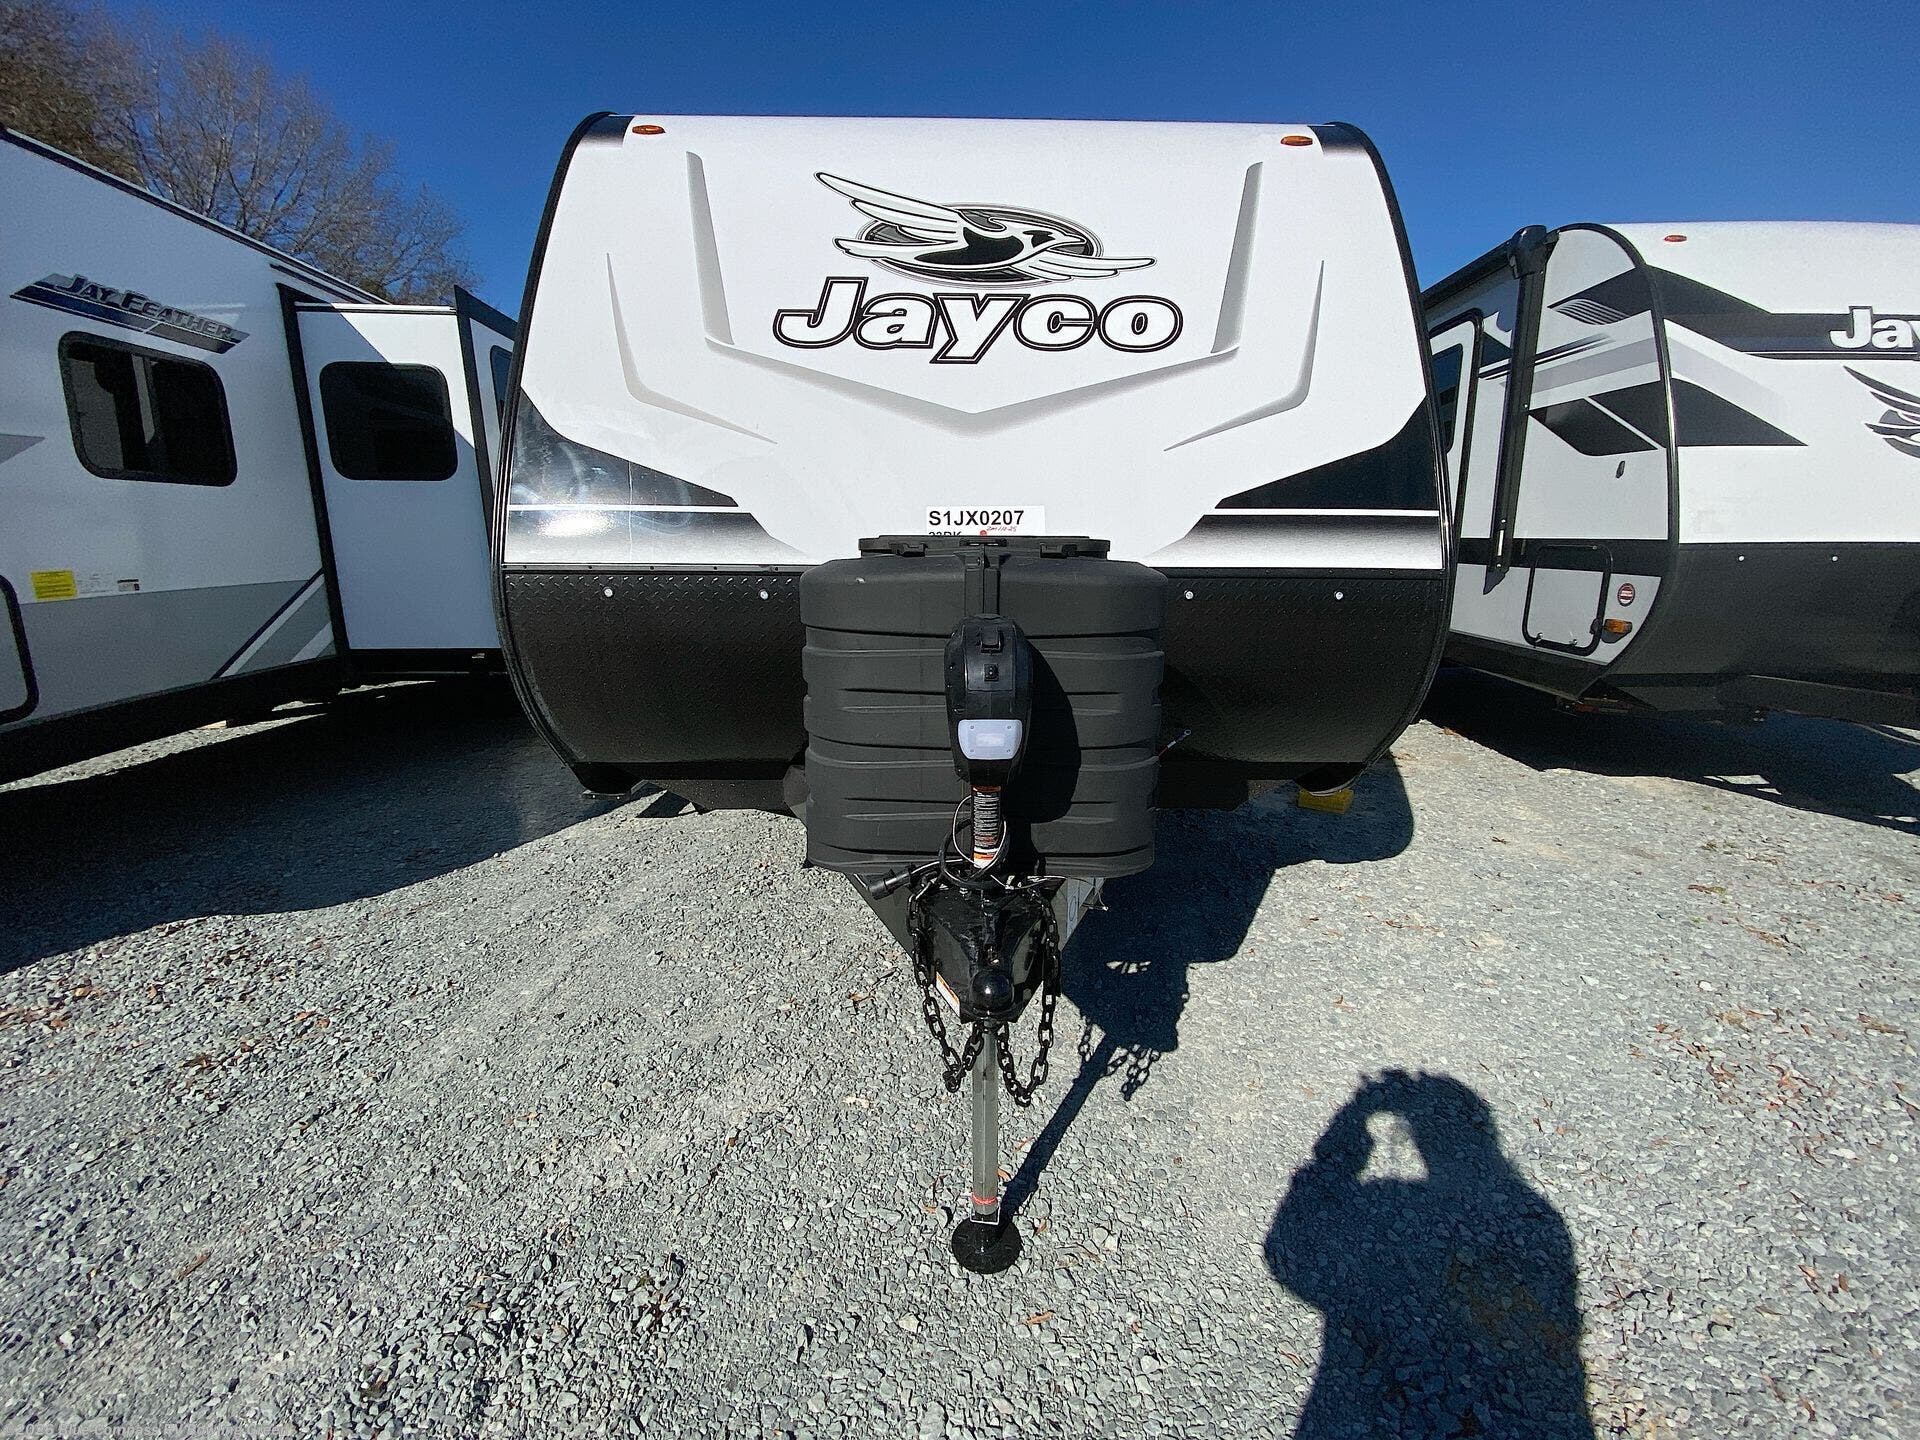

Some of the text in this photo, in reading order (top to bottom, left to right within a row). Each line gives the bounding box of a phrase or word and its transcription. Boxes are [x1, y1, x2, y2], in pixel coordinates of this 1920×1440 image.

[54, 274, 234, 341] JAY FEATHER
[772, 276, 1183, 364] Jayco
[928, 510, 1025, 526] S1JX0207
